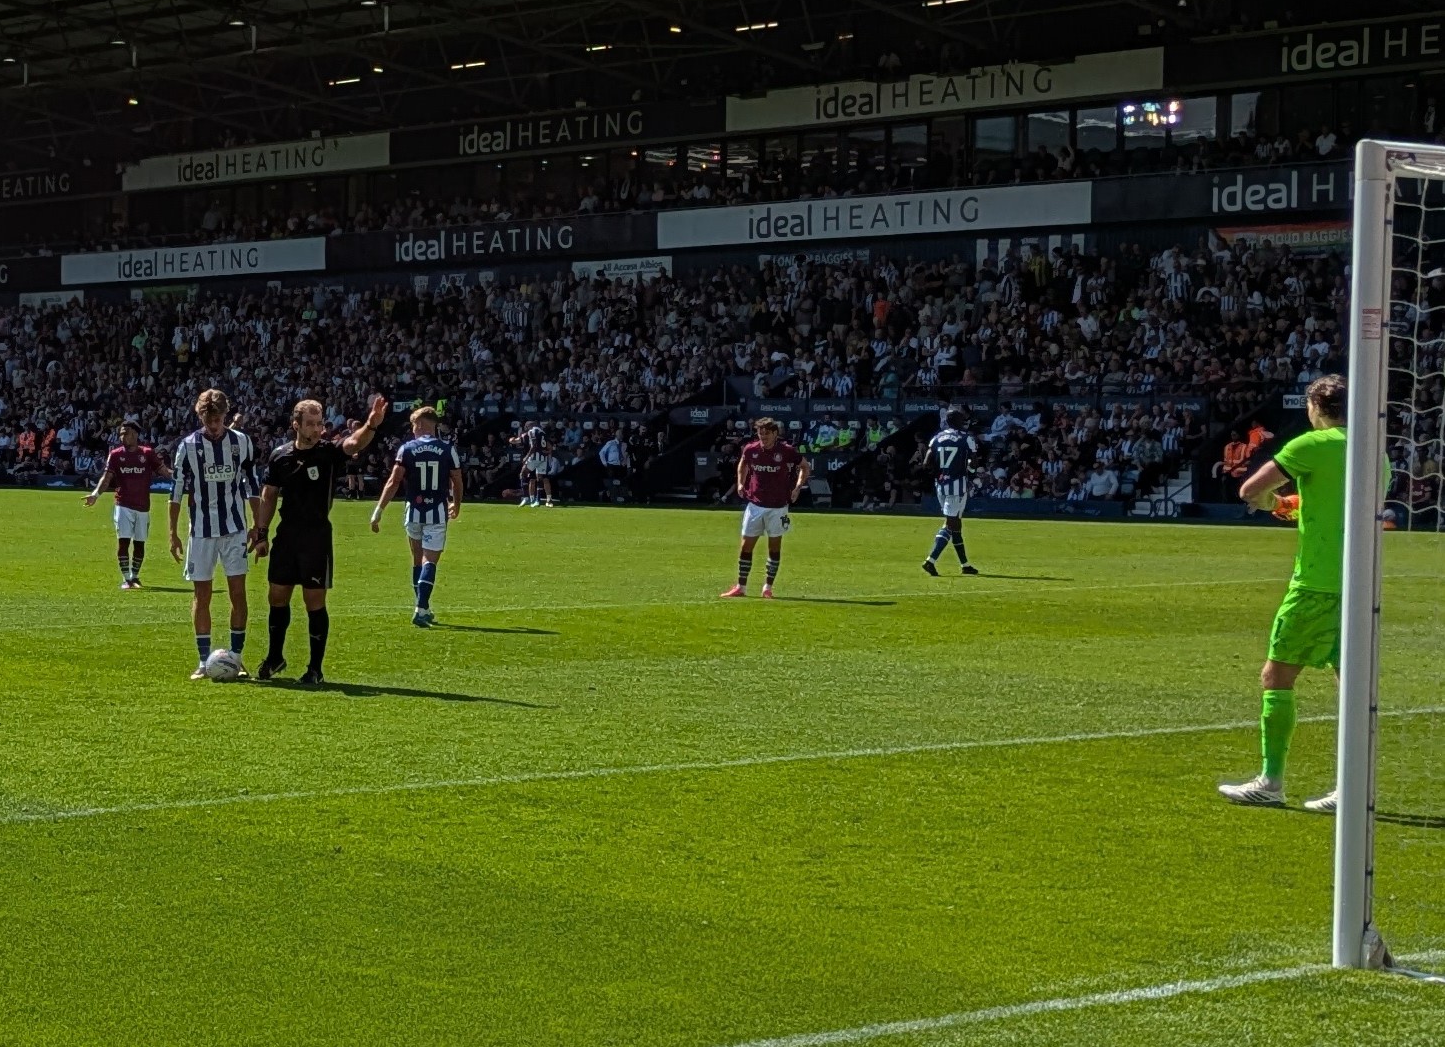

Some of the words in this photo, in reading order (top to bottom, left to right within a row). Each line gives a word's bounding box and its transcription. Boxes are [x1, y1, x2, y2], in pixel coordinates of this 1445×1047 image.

[1281, 26, 1370, 72] ideal
[815, 82, 883, 121] ideal
[891, 66, 1054, 110] HEATING
[459, 121, 511, 155] ideal
[518, 110, 644, 146] HEATING
[178, 151, 221, 183] ideal
[225, 145, 326, 175] HEATING
[1212, 170, 1298, 213] ideal
[747, 202, 813, 240] ideal
[822, 195, 981, 233] HEATING
[395, 230, 446, 263] ideal
[452, 225, 574, 255] HEATING
[117, 251, 158, 280] ideal
[163, 247, 260, 274] HEATING
[690, 407, 709, 418] ideal
[411, 444, 444, 457] MORGAN
[937, 446, 959, 469] 17
[415, 460, 439, 491] 11
